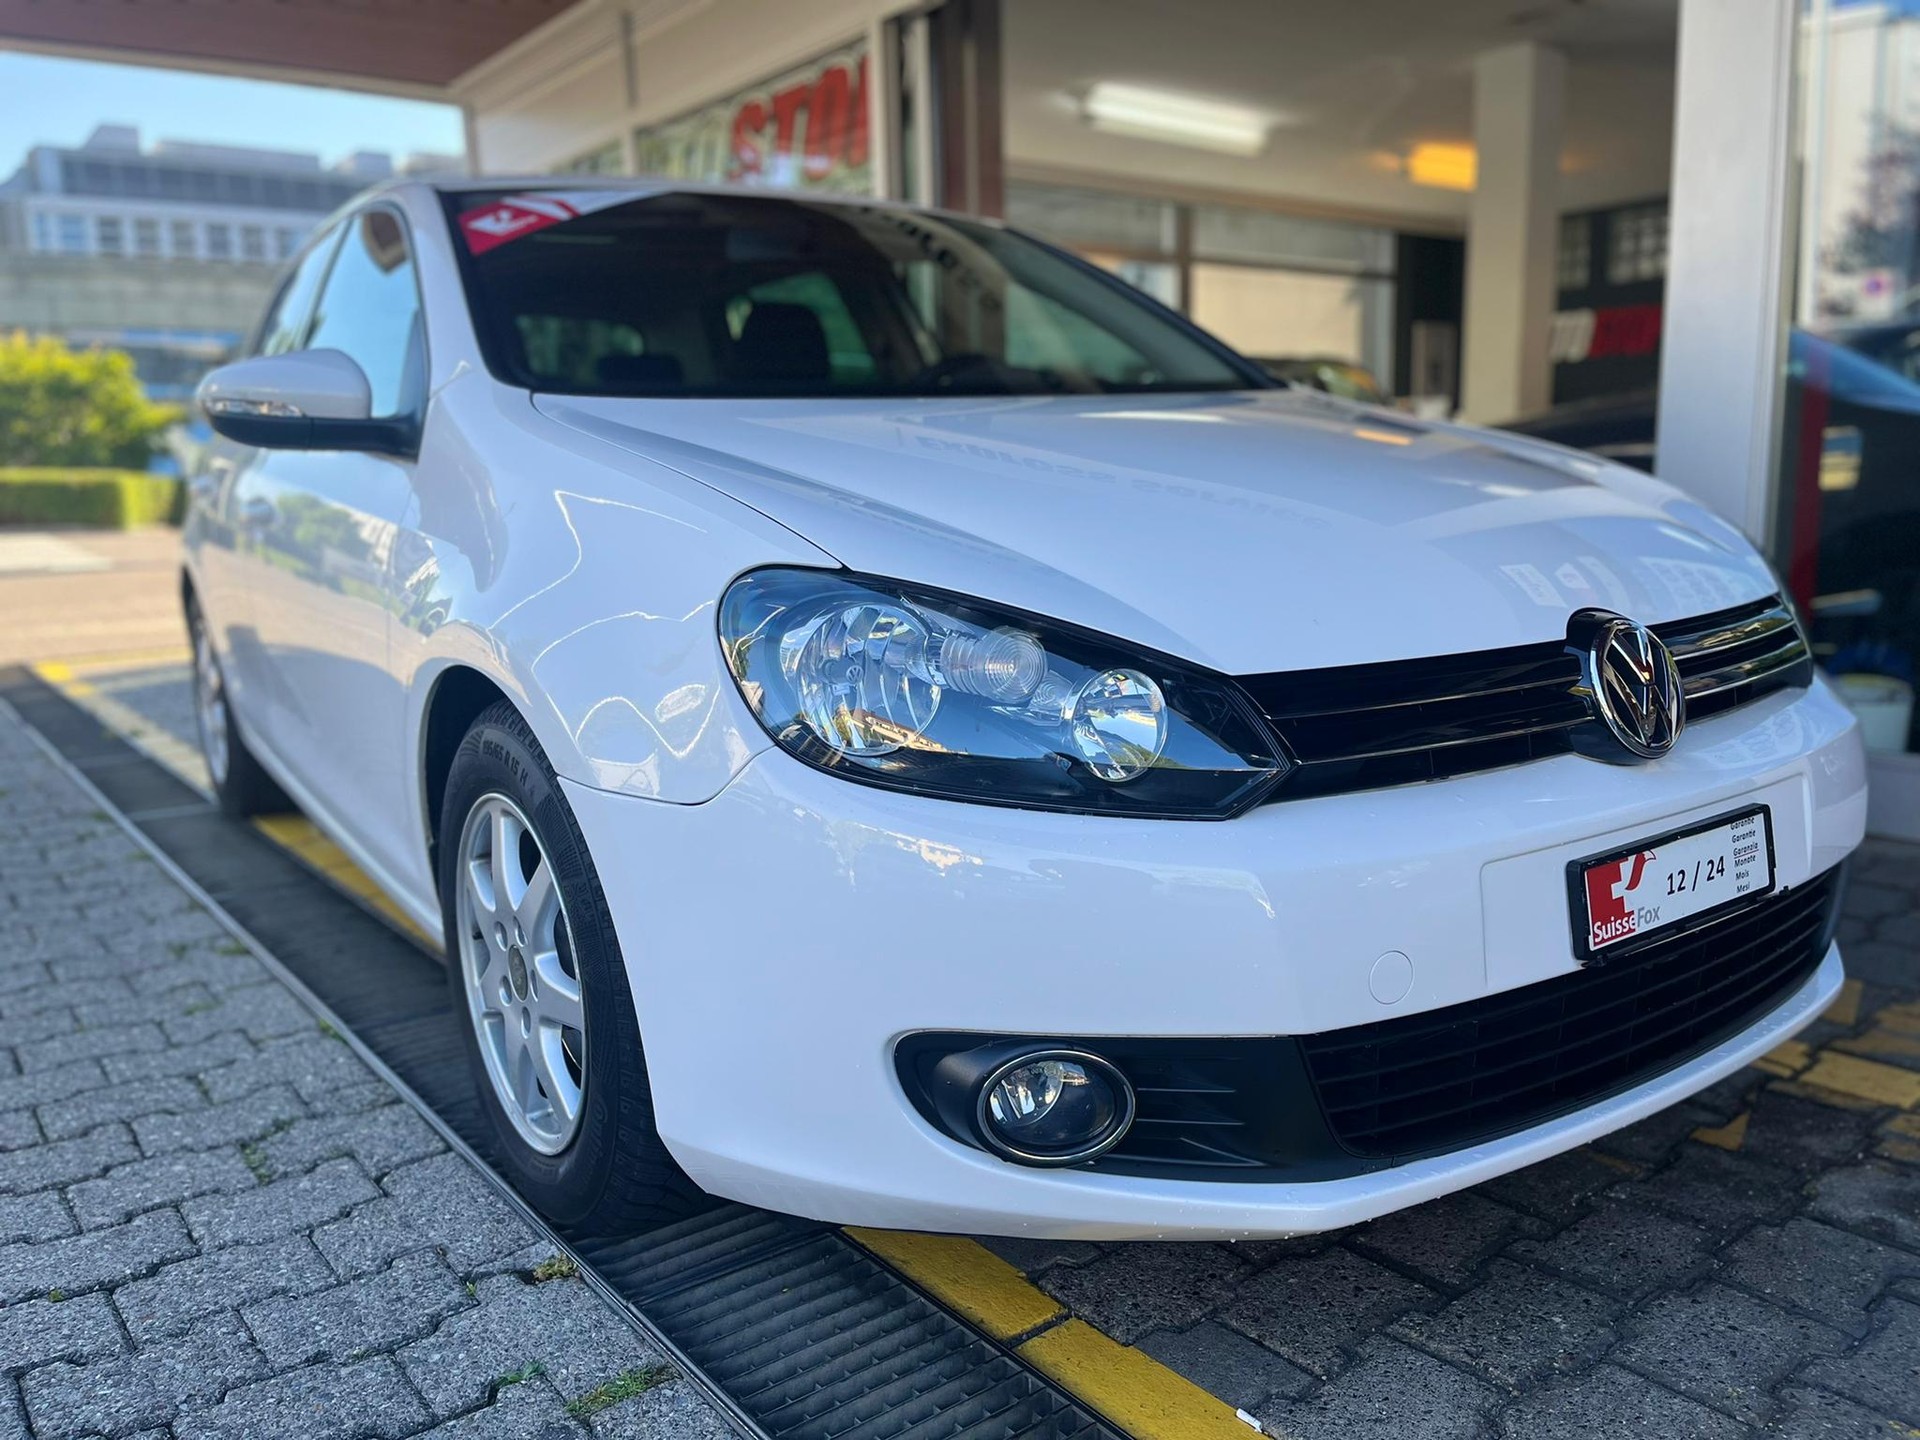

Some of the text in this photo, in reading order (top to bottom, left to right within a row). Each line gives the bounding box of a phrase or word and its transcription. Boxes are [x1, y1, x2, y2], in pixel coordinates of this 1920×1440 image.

[1732, 829, 1756, 844] Garantie
[1733, 841, 1759, 857] Garanzia
[1734, 854, 1756, 869] Monate
[1667, 856, 1725, 896] 12 / 24
[1735, 868, 1750, 881] Mois
[1736, 881, 1751, 894] Mesi
